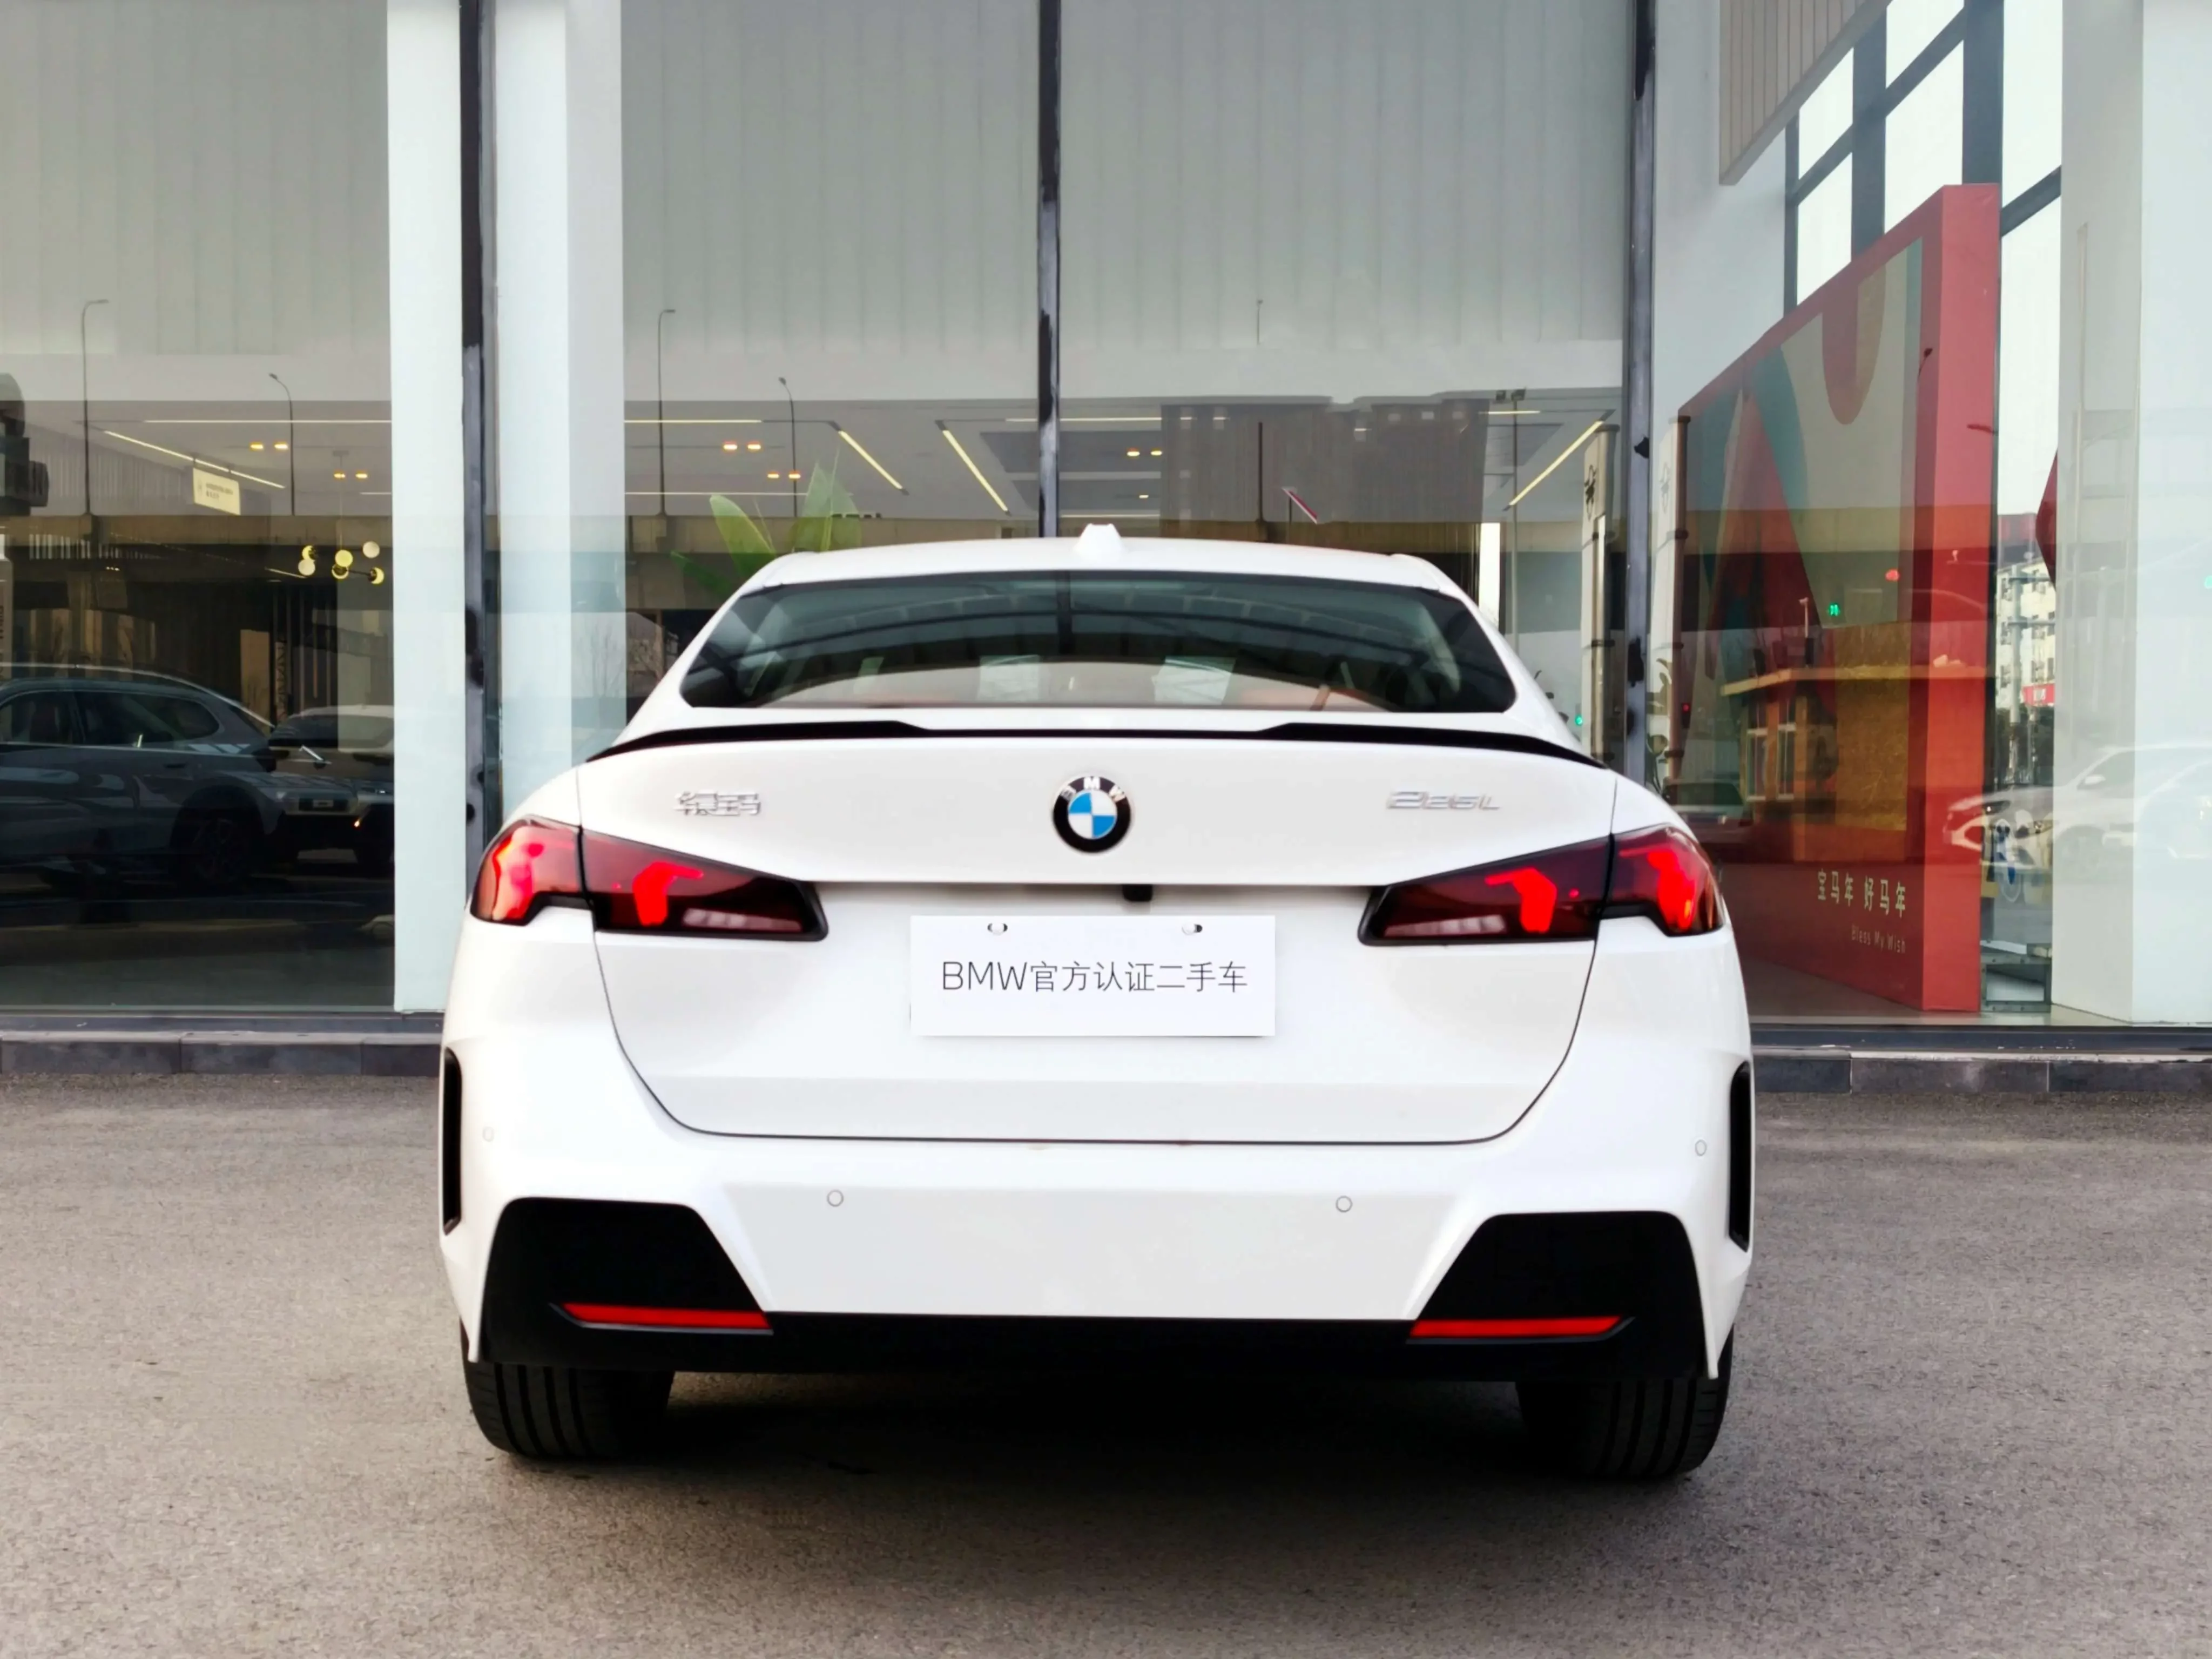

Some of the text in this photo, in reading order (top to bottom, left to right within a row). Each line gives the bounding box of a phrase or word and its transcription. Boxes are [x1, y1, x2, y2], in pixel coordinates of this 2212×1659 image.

[1817, 868, 1906, 919] 宝马年 好马年
[941, 960, 1249, 993] BMW官方认证二手车
